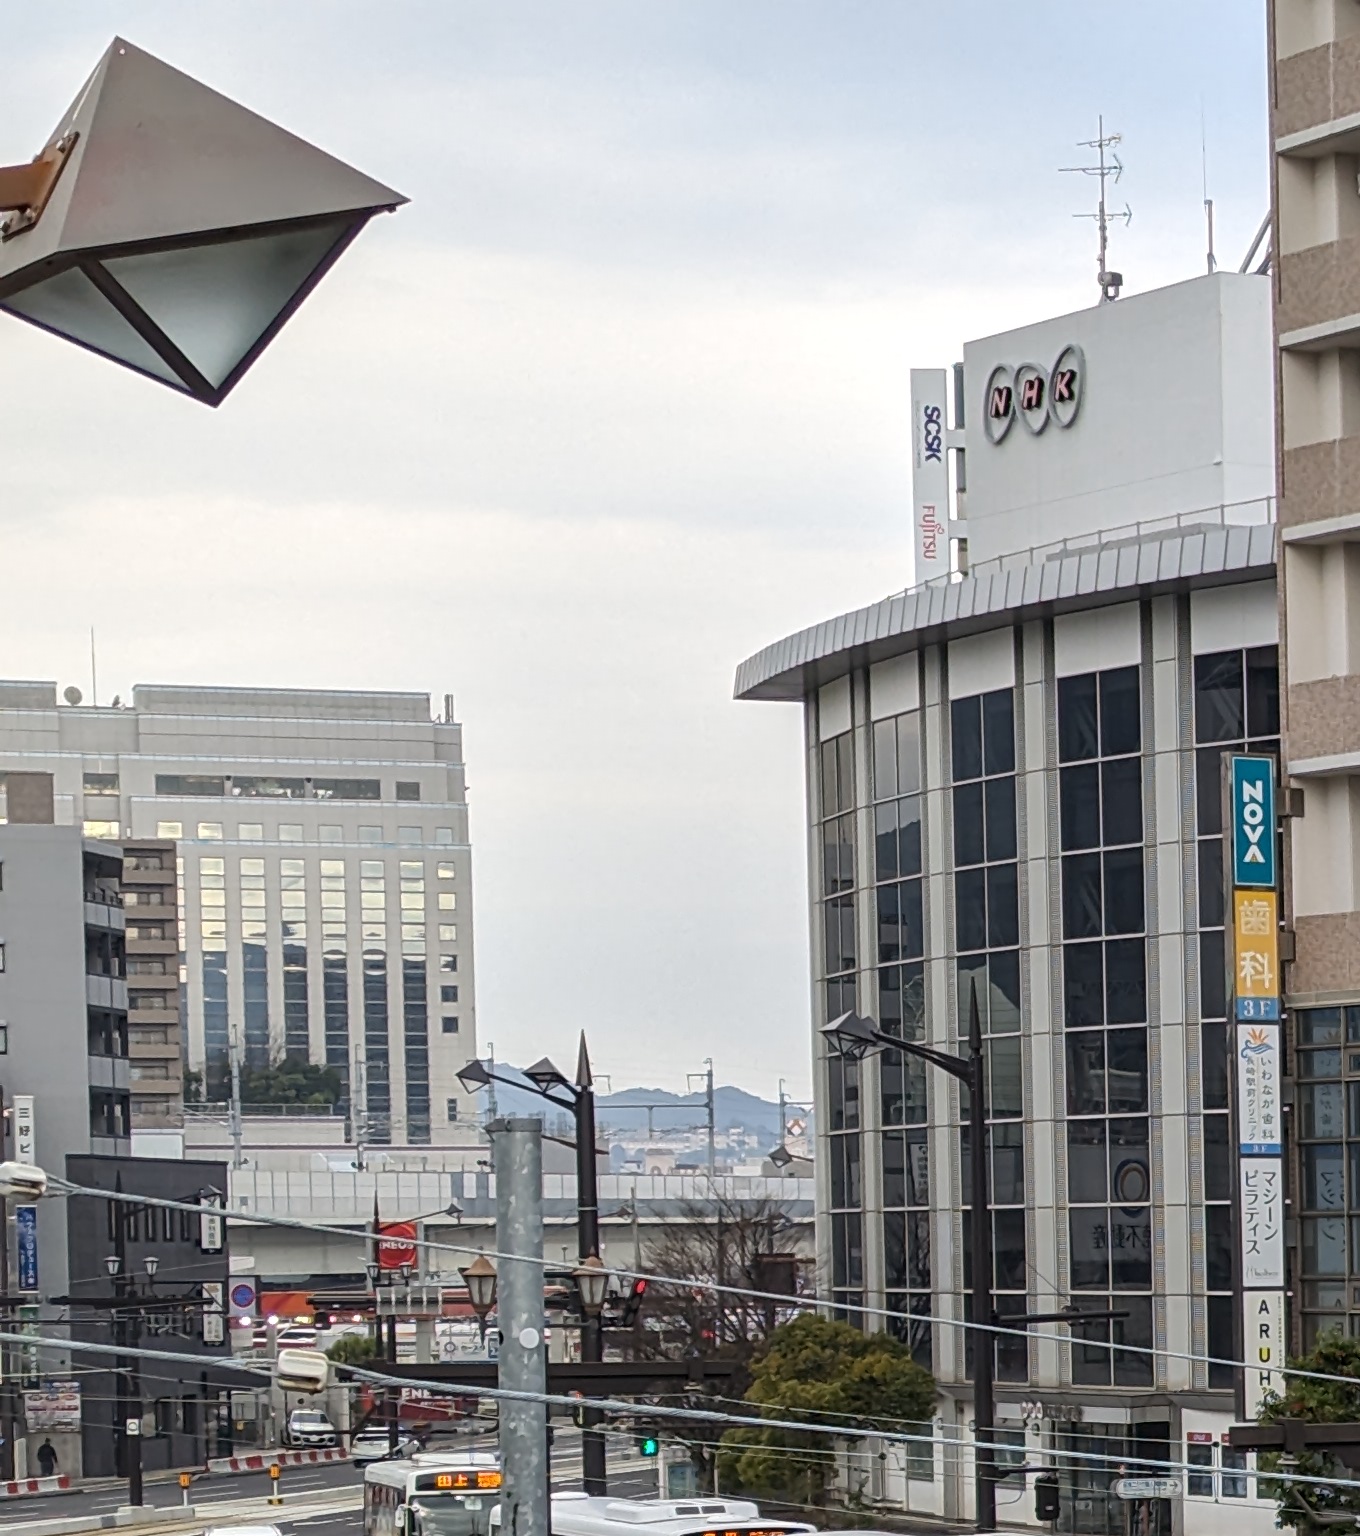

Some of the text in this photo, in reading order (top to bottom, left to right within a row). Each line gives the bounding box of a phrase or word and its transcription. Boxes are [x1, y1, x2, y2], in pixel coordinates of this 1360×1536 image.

[923, 404, 942, 464] SCSK
[920, 504, 945, 560] FUJITSU
[1241, 779, 1266, 863] NOVA
[1239, 899, 1273, 990] 歯科
[1243, 1000, 1271, 1016] 3F
[1260, 1057, 1275, 1140] いわなが歯科
[18, 1107, 31, 1165] 三好ビ
[1244, 1169, 1260, 1255] ピラティス
[1262, 1171, 1278, 1241] マシーン
